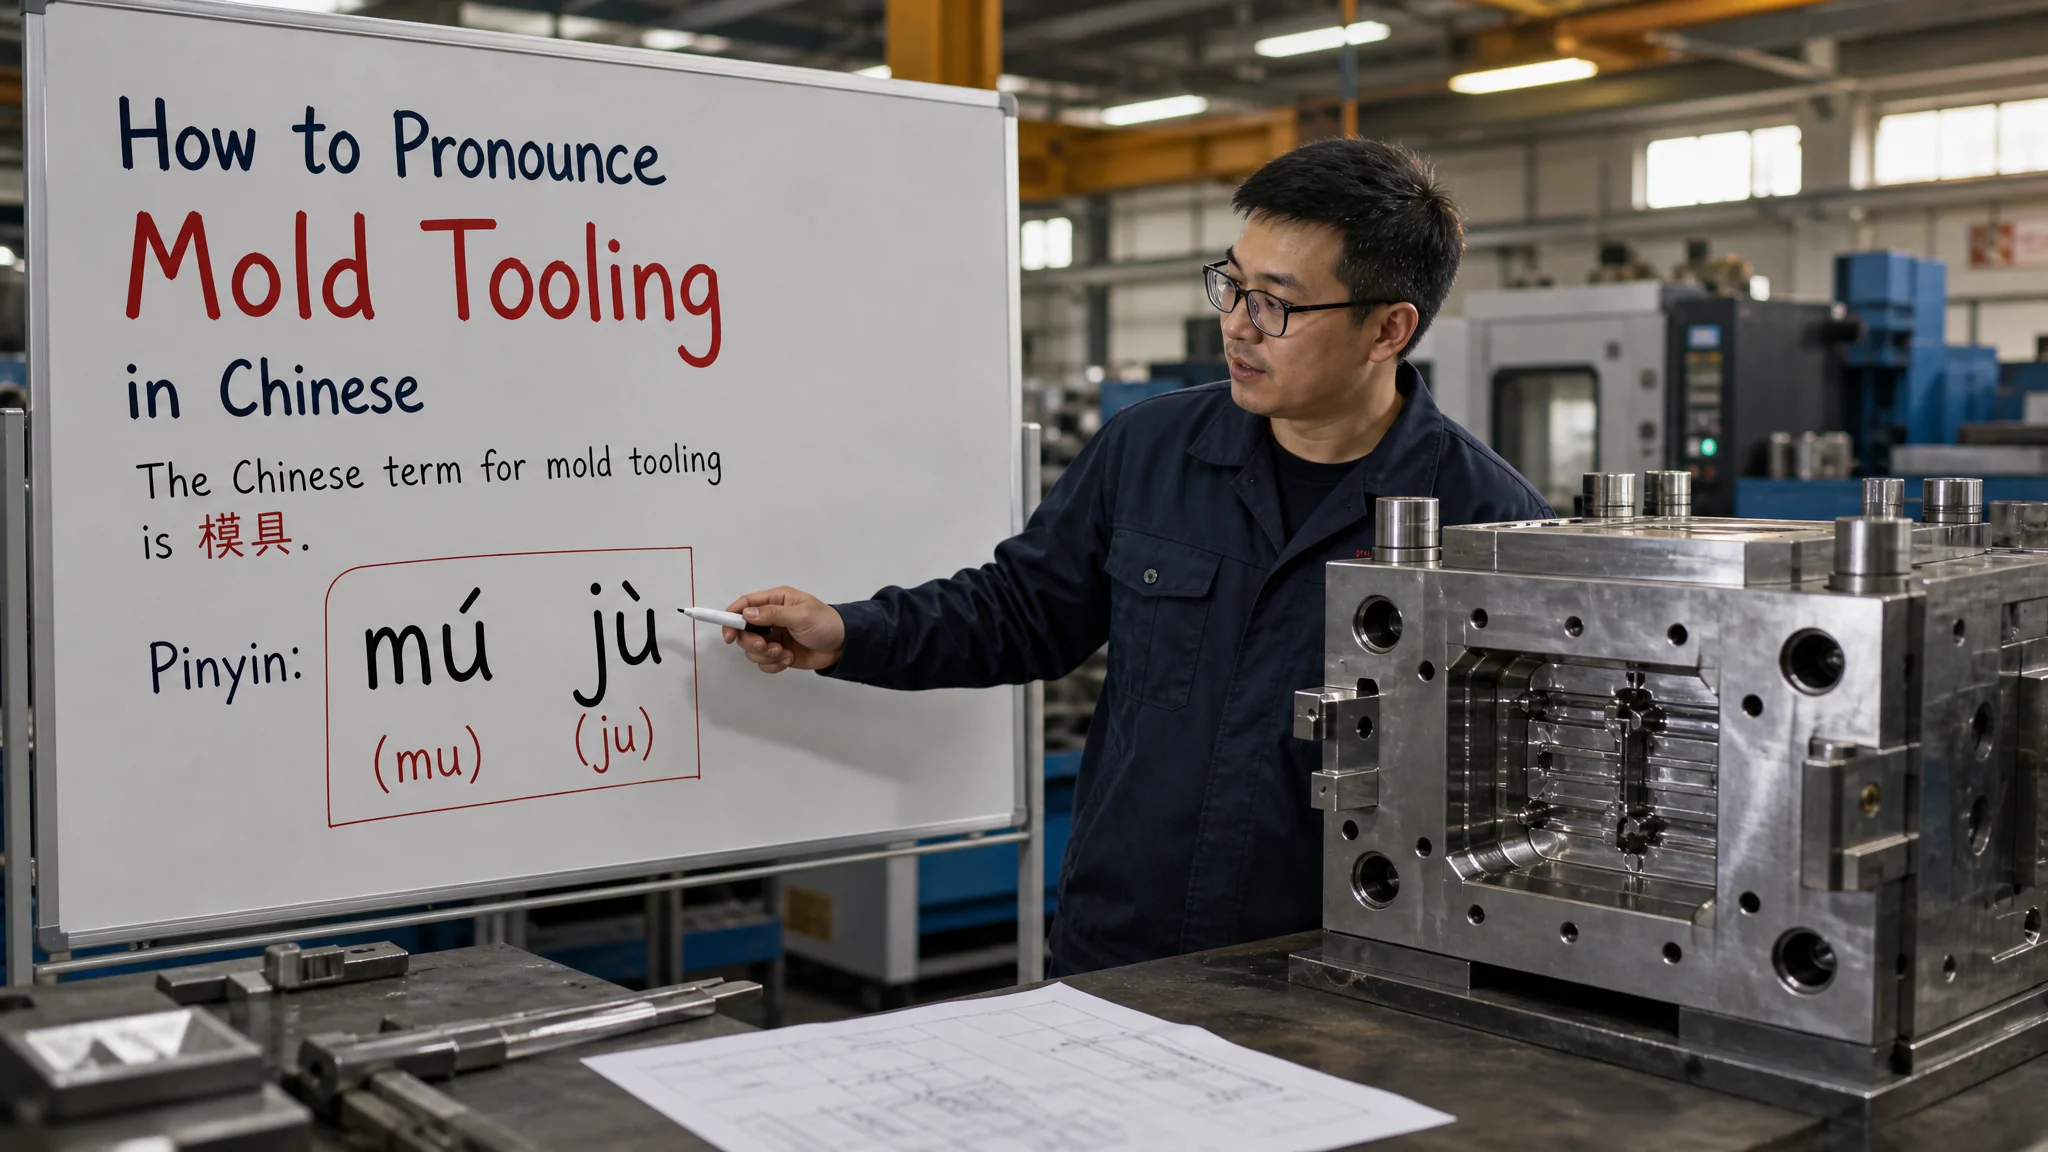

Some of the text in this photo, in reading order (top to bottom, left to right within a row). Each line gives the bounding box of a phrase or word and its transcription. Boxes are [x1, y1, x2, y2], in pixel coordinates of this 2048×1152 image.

[119, 95, 667, 186] How to Pronounce
[126, 210, 721, 368] Mold Tooling
[127, 357, 424, 420] in Chinese
[136, 443, 721, 499] The Chinese term for mold tooling
[143, 525, 172, 559] is
[150, 580, 662, 708] Pinyin: mú jù
[374, 706, 653, 794] (mu) (ju)
